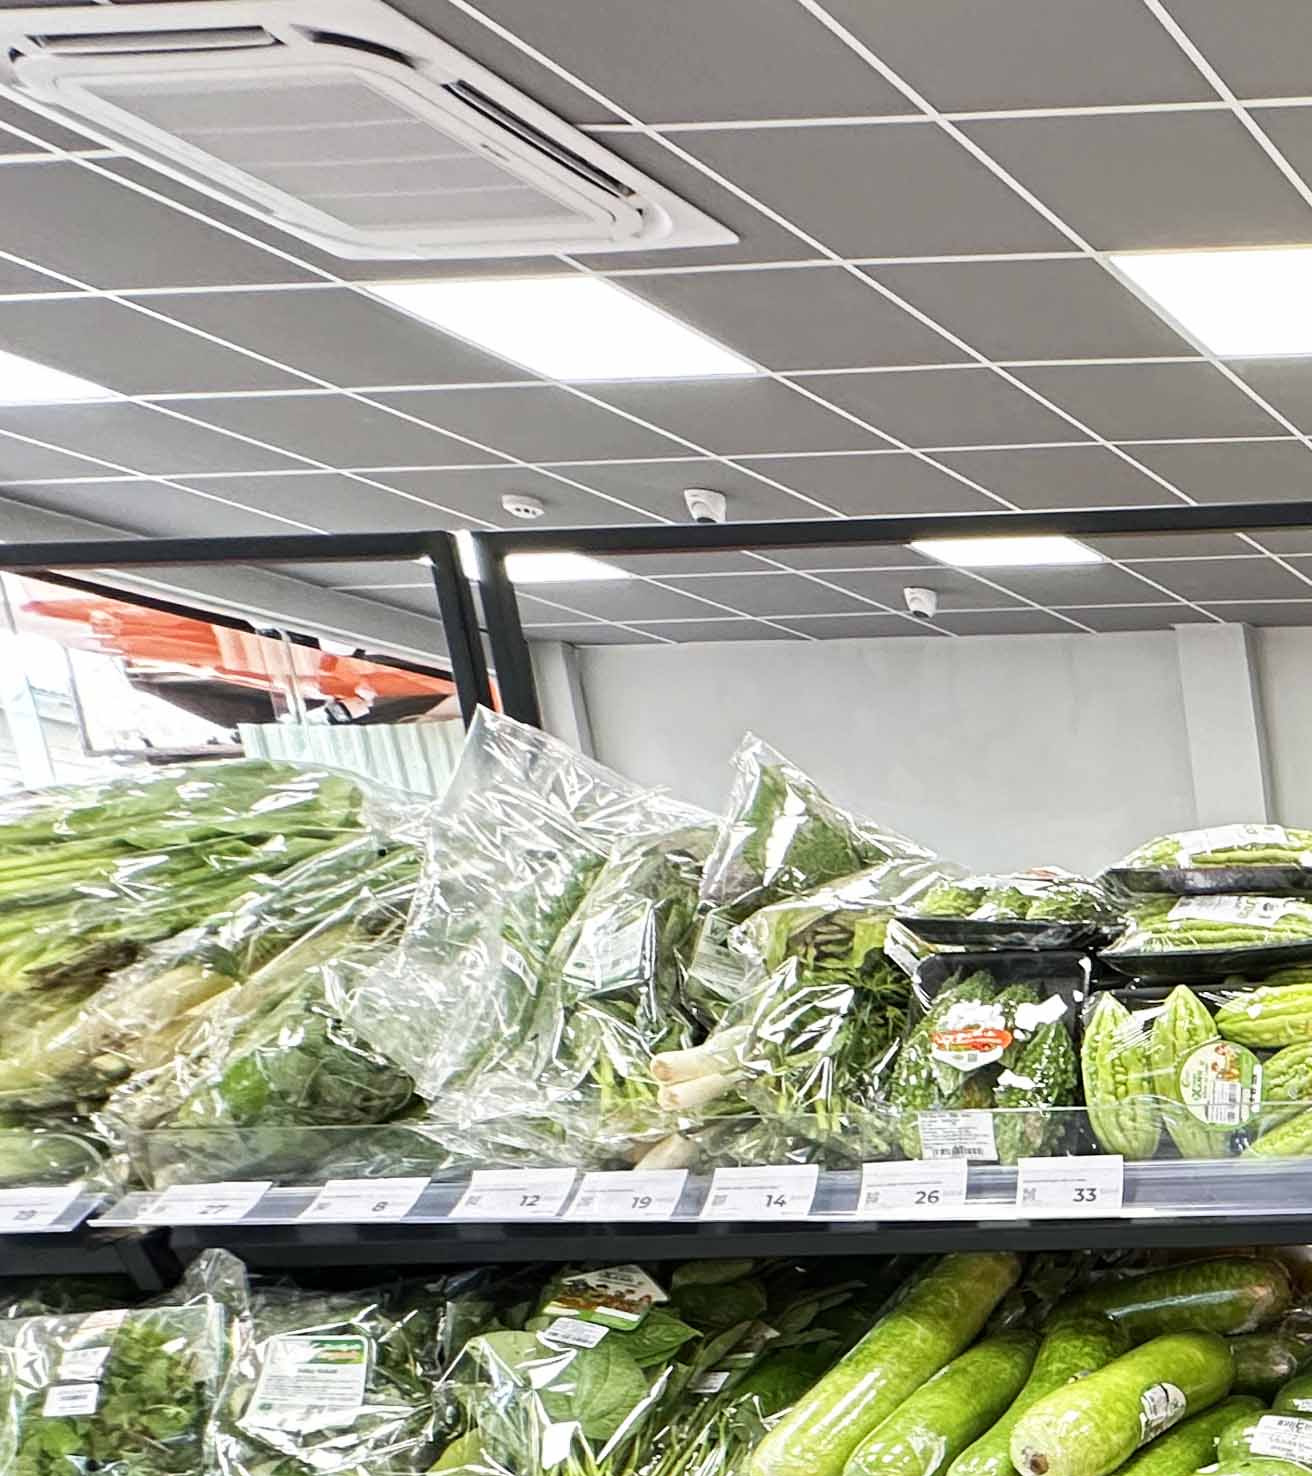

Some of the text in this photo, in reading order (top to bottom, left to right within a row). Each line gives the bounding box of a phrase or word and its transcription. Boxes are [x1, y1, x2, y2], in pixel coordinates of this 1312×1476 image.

[519, 1194, 541, 1207] 12
[631, 1195, 653, 1209] 19
[766, 1194, 787, 1208] 14
[914, 1189, 940, 1205] 26
[1072, 1187, 1097, 1203] 33
[371, 1201, 389, 1212] 8
